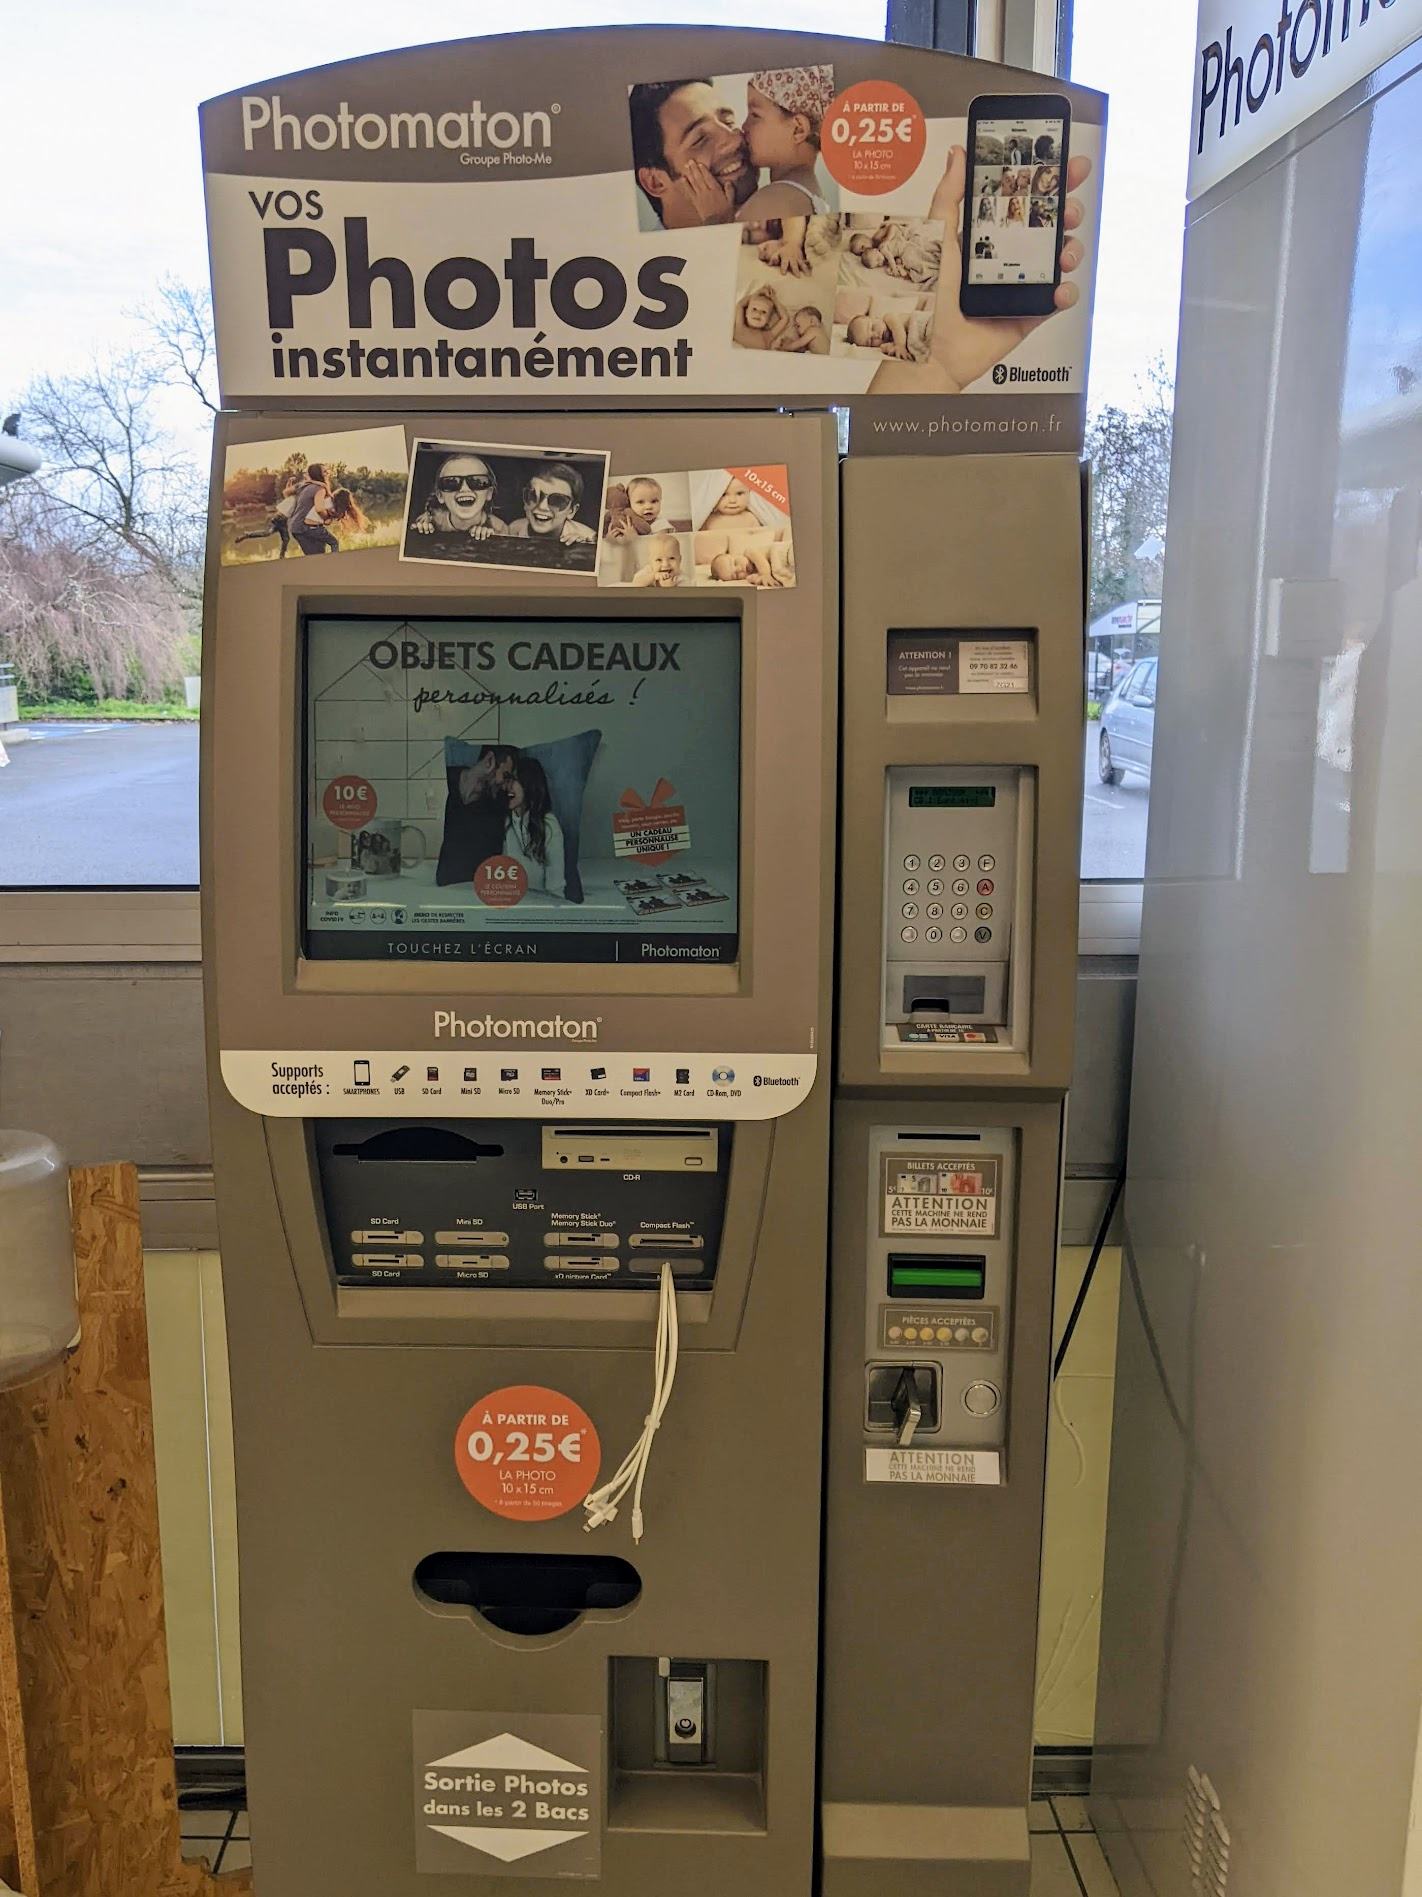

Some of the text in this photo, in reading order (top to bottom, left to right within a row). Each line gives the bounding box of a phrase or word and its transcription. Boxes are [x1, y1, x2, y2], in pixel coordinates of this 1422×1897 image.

[853, 103, 889, 112] PARTIR
[892, 103, 905, 112] DE
[852, 150, 894, 159] LA PHOTO
[460, 153, 552, 167] Groupe Photo-Me
[854, 160, 863, 170] 10
[870, 160, 879, 170] 15
[263, 217, 689, 330] Photos
[271, 332, 693, 378] instantanément
[873, 414, 1062, 438] www.photomaton.fr
[744, 469, 786, 503] 10x15 cm
[368, 641, 682, 672] OBJETS CADEAUX
[899, 651, 946, 660] ATTENTION
[969, 663, 979, 671] 09
[979, 663, 989, 671] 70
[413, 677, 646, 713] personnalisés !
[643, 826, 673, 837] CADEAU
[636, 844, 665, 854] UNIQUE
[909, 859, 990, 868] 1 2 3 F
[907, 883, 990, 891] 4 5 6 A
[907, 907, 988, 916] 7 8 9 C
[930, 930, 987, 940] 0 V
[387, 941, 538, 955] TOUCHEZ L'ÉCRAN
[271, 1062, 324, 1081] Supports
[272, 1080, 322, 1098] acceptés
[394, 1087, 405, 1095] USB
[533, 1088, 556, 1097] Memory
[620, 1088, 643, 1098] Compact
[673, 1089, 695, 1097] M2 Card
[730, 1089, 742, 1097] DVD
[541, 1098, 565, 1106] Duo/Pro
[907, 1161, 976, 1171] BILLETS ACCEPTÉS
[891, 1197, 988, 1210] ATTENTION
[551, 1213, 580, 1221] Memory
[891, 1209, 912, 1217] CETTE
[456, 1218, 483, 1226] Mini SD
[551, 1220, 580, 1228] Memory
[640, 1221, 672, 1230] Compact
[891, 1217, 987, 1228] PAS LA MONNAIE
[457, 1271, 489, 1279] Micro SD
[902, 1315, 976, 1326] PIÈCES ACCEPTÉES
[482, 1411, 569, 1426] À PARTIR DE
[890, 1451, 975, 1466] ATTENTION
[499, 1470, 556, 1481] LA PHOTO
[889, 1471, 976, 1482] PAS LA MONNAIE
[502, 1482, 513, 1494] 10
[524, 1482, 536, 1494] 15
[539, 1486, 554, 1494] cm
[423, 1772, 589, 1796] Sortie Photos
[423, 1799, 589, 1821] dans les 2 Bacs
